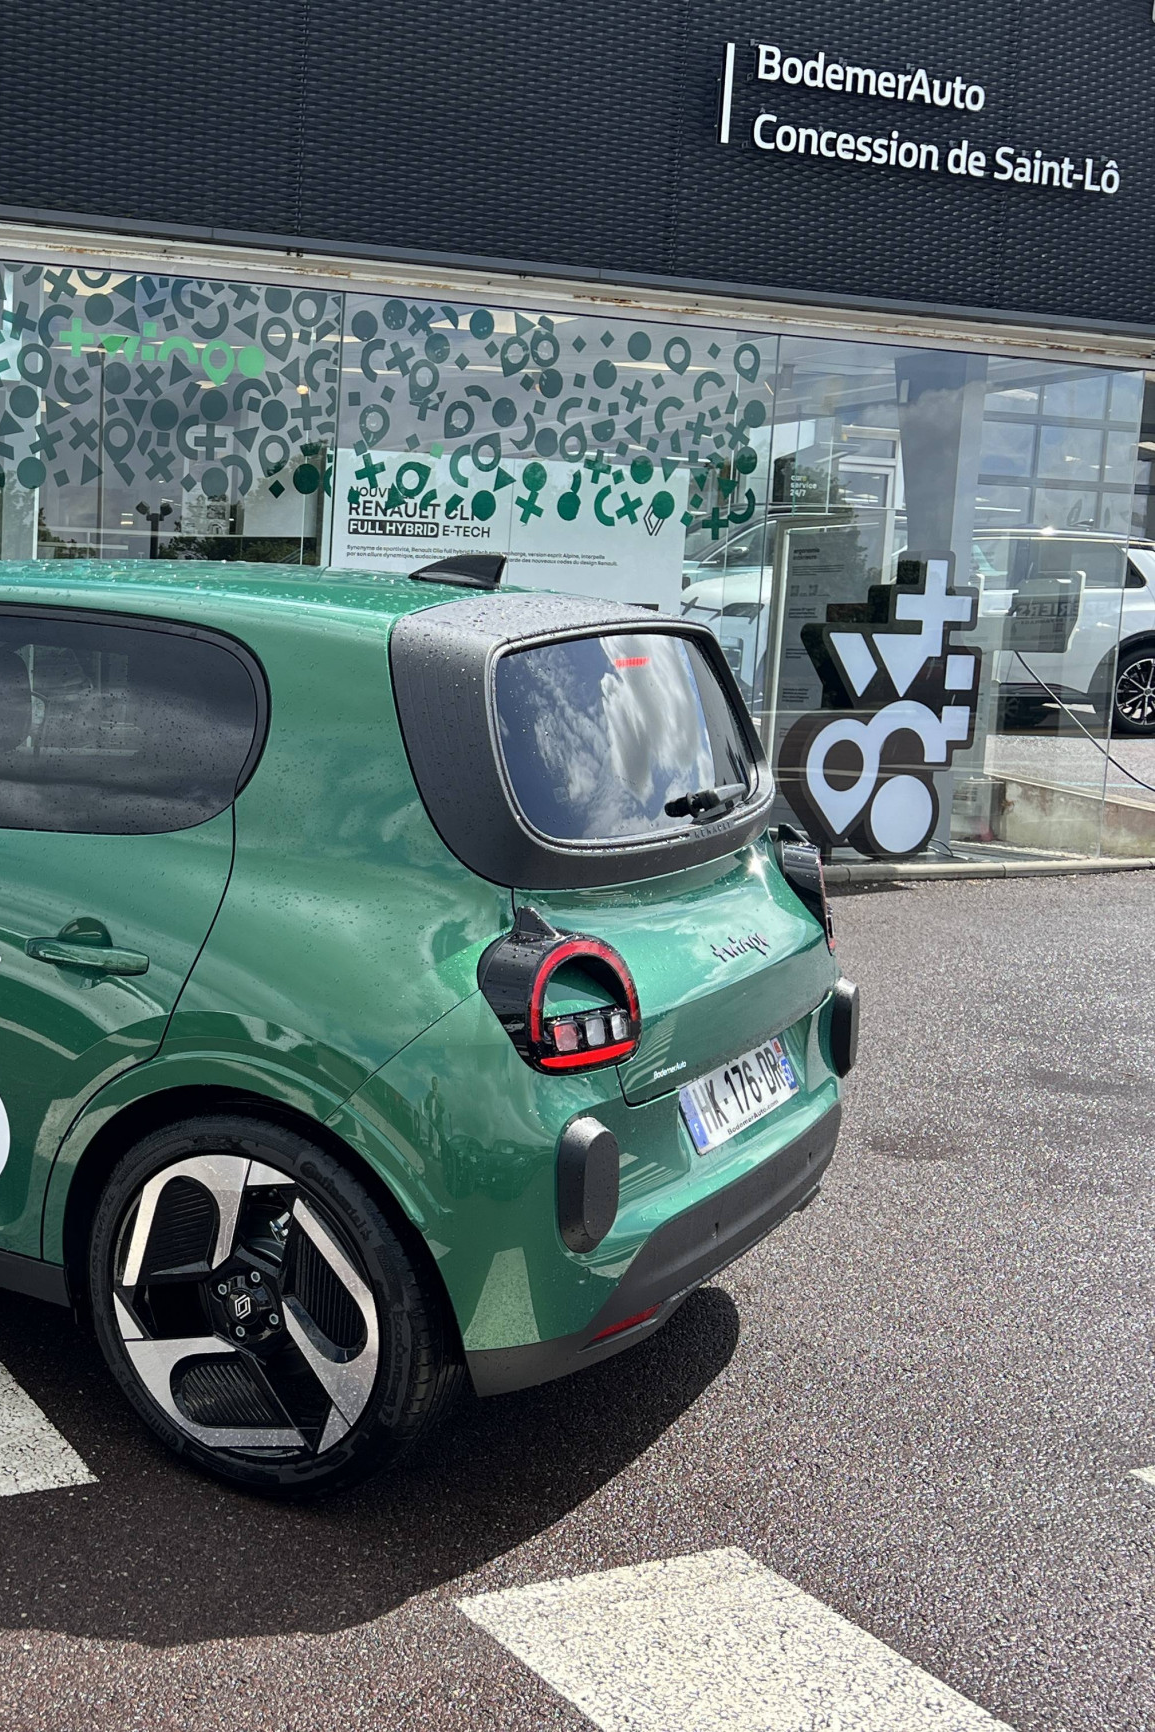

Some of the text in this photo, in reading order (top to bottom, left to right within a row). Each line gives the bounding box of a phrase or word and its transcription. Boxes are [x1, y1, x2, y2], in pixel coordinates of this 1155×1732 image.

[756, 44, 986, 112] BodemerAuto
[752, 113, 1121, 195] Concession de Saint-Lô
[349, 520, 491, 538] FULL HYBRID E-TECH
[692, 1046, 787, 1134] HK-176-DR
[693, 1122, 701, 1137] F
[727, 1099, 780, 1135] BodemerAuto.com
